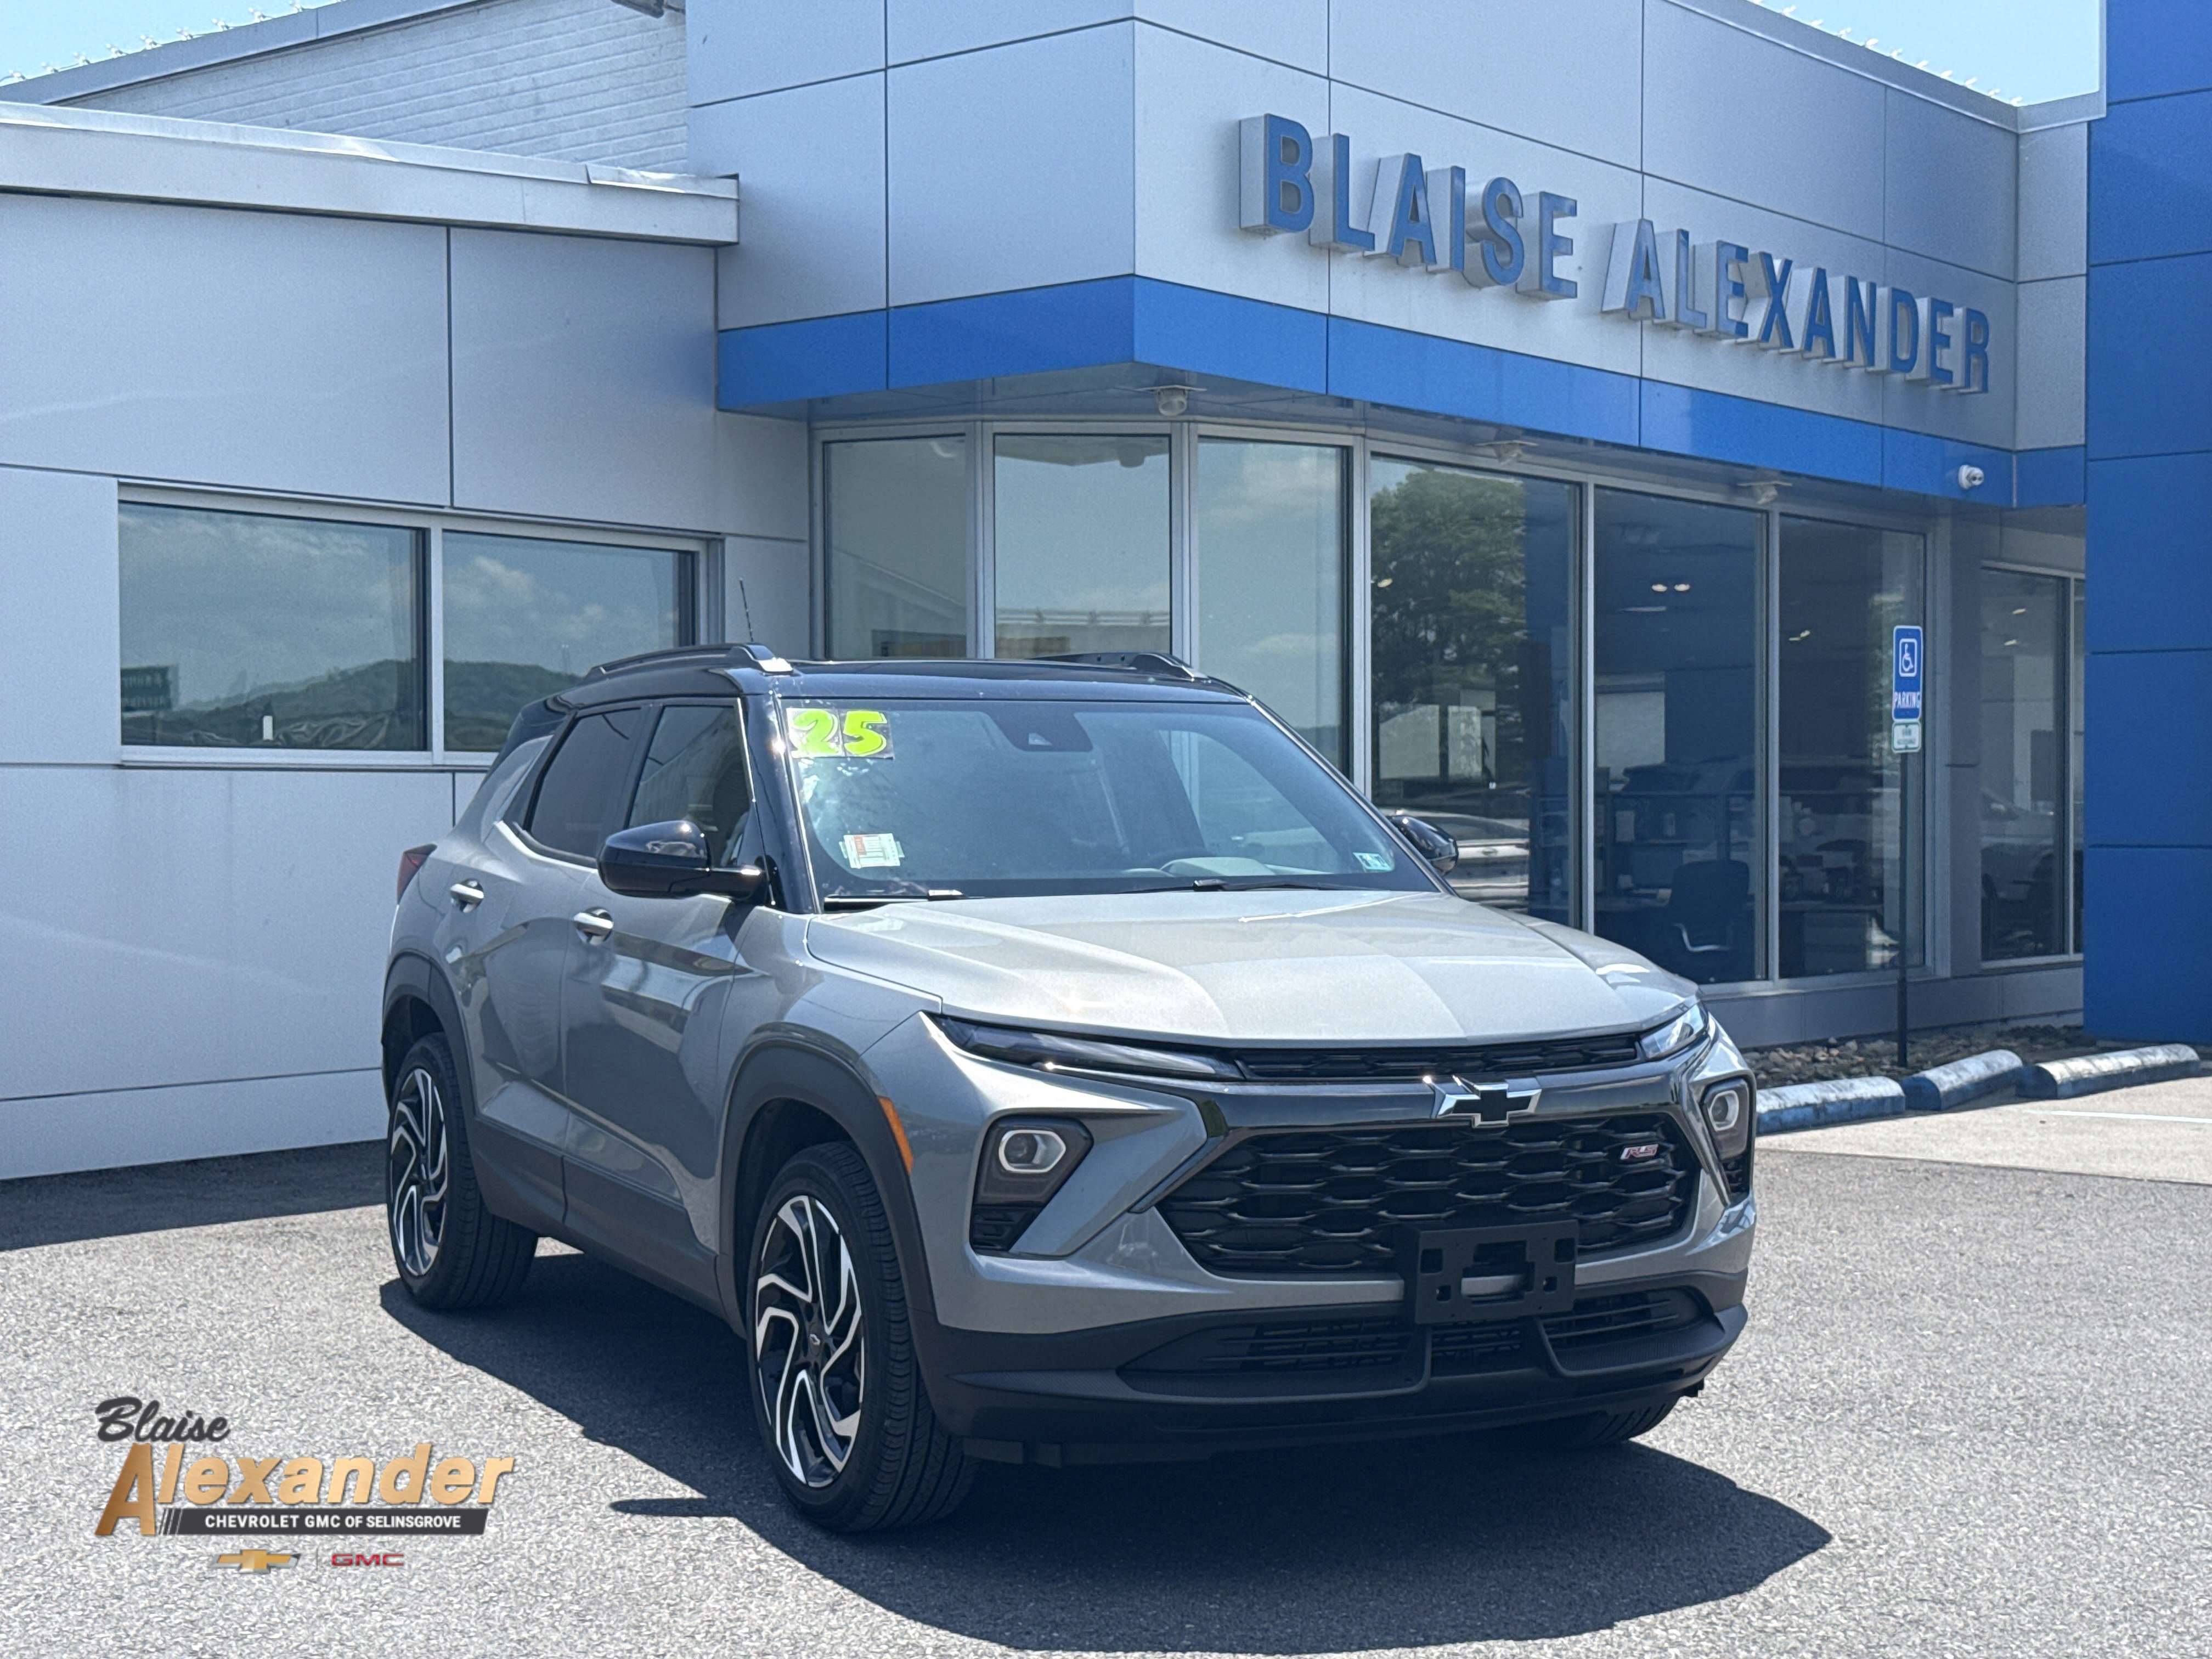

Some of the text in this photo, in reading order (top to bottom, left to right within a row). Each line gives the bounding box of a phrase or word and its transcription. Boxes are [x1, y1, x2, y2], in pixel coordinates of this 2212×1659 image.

[1265, 114, 1989, 394] BLAISE ALEXANDER
[1893, 691, 1920, 708] PARKING
[792, 708, 888, 757] 25
[1620, 1144, 1659, 1160] RS
